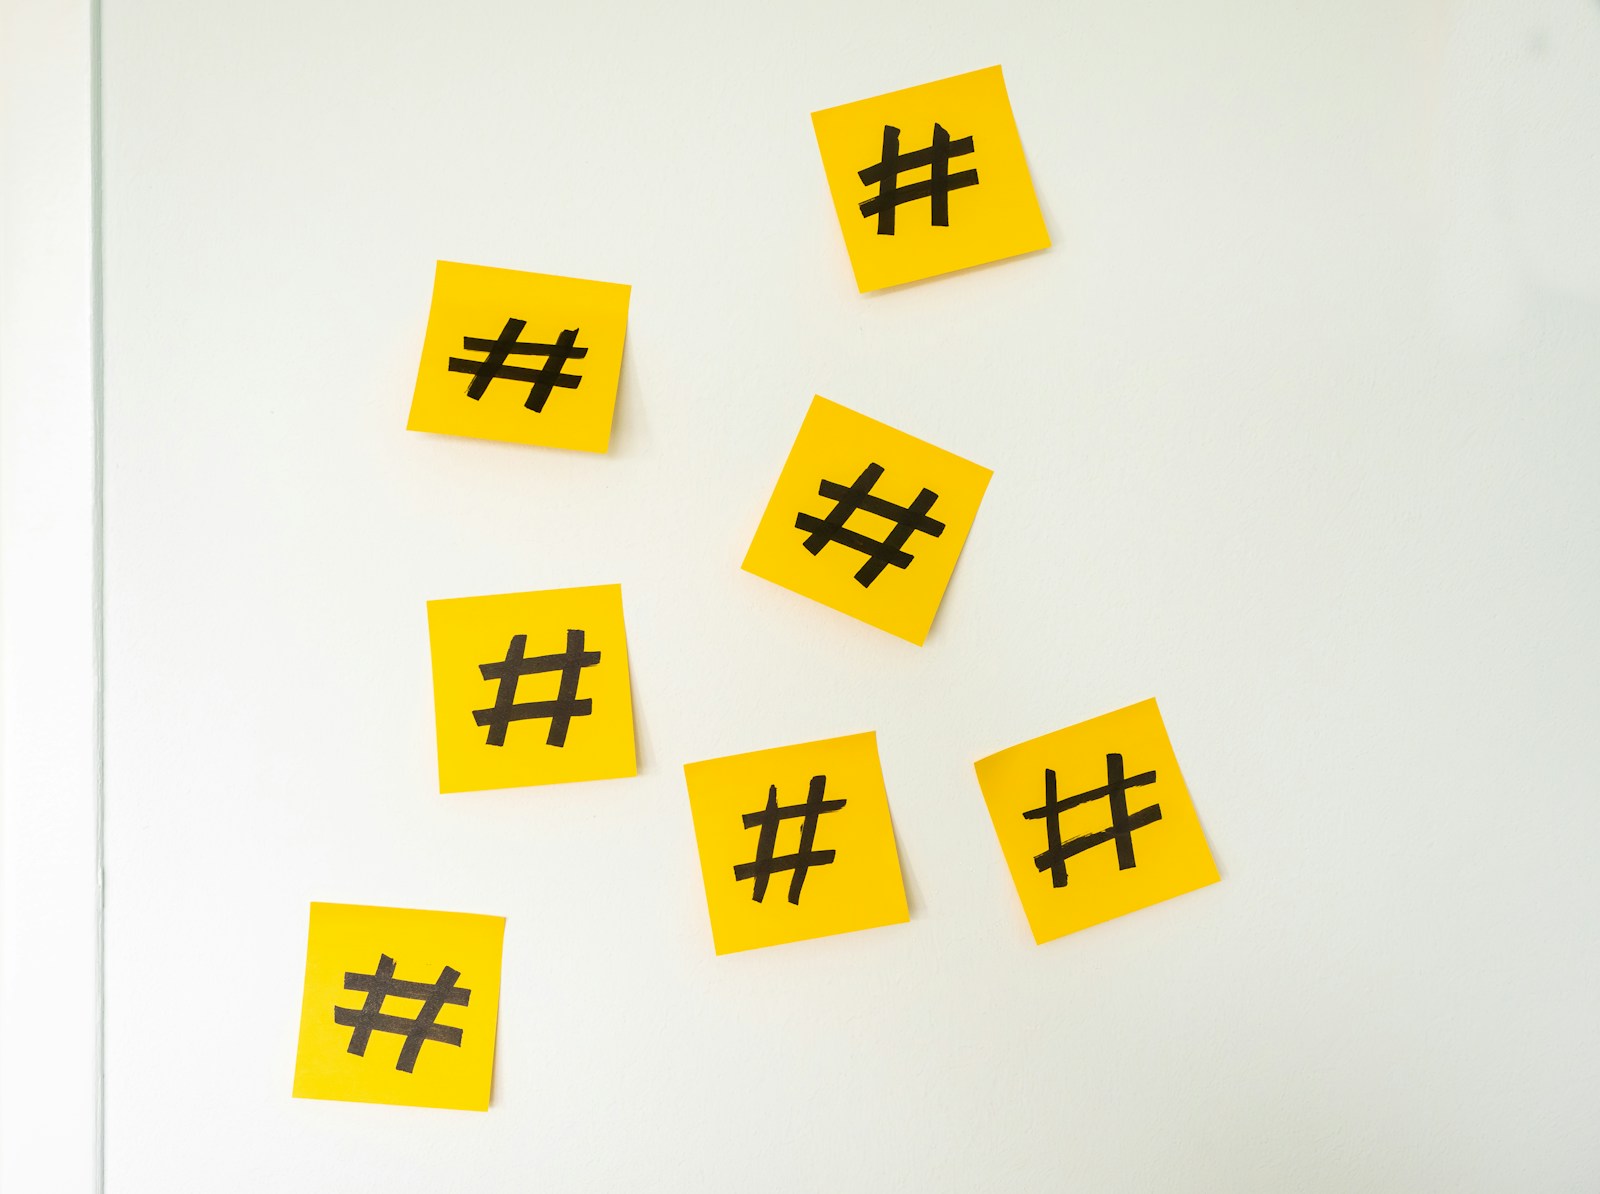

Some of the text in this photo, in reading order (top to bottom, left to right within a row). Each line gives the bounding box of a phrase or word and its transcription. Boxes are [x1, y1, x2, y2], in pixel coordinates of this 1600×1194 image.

[857, 122, 980, 236] #
[448, 317, 589, 414] #
[794, 462, 946, 589] #
[471, 629, 601, 748] #
[733, 774, 848, 906] #
[1022, 752, 1163, 889] #
[334, 953, 472, 1074] #
